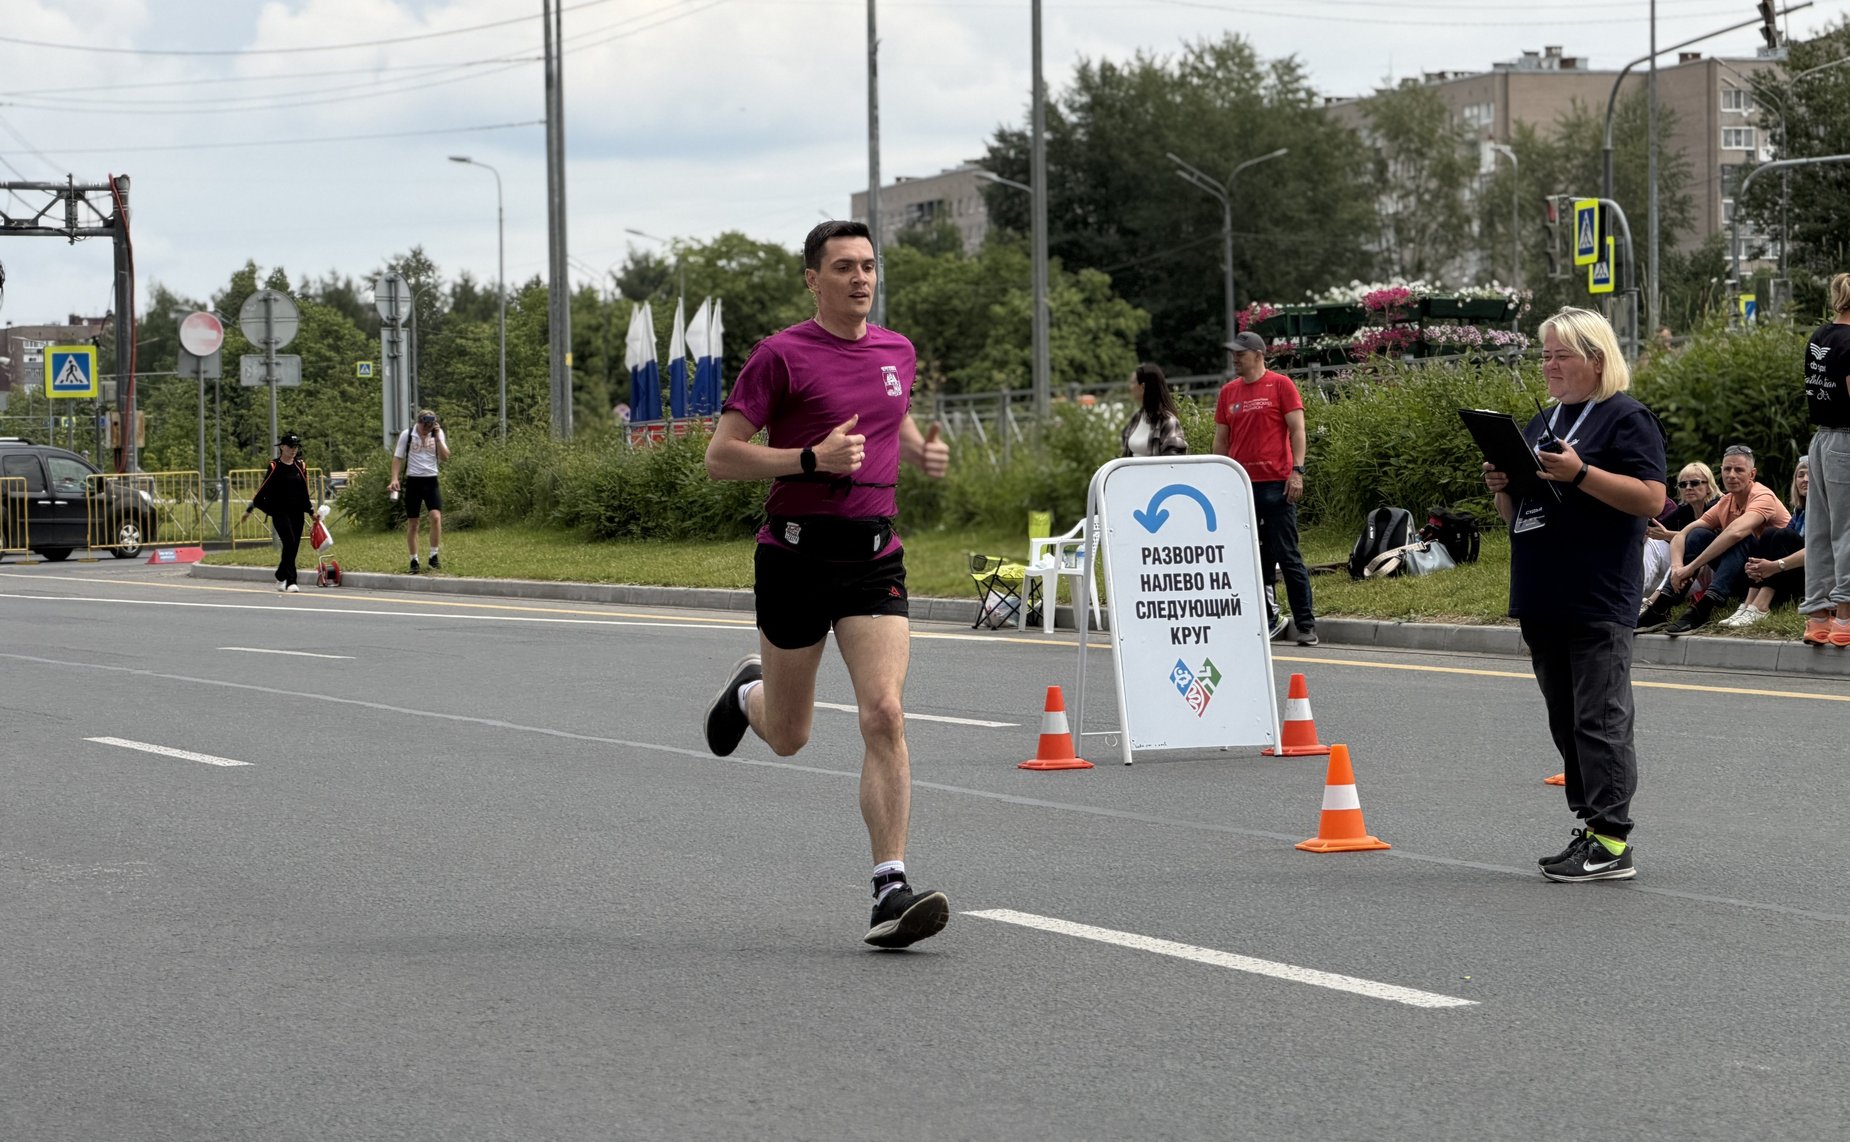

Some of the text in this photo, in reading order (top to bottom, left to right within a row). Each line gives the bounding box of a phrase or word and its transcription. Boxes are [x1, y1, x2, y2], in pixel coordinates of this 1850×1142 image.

[1141, 545, 1225, 565] РАЗВОРОТ
[1140, 572, 1232, 592] НАЛЕВО НА
[1135, 593, 1242, 621] СЛЕДУЮЩИЙ
[1170, 626, 1211, 645] КРУГ
